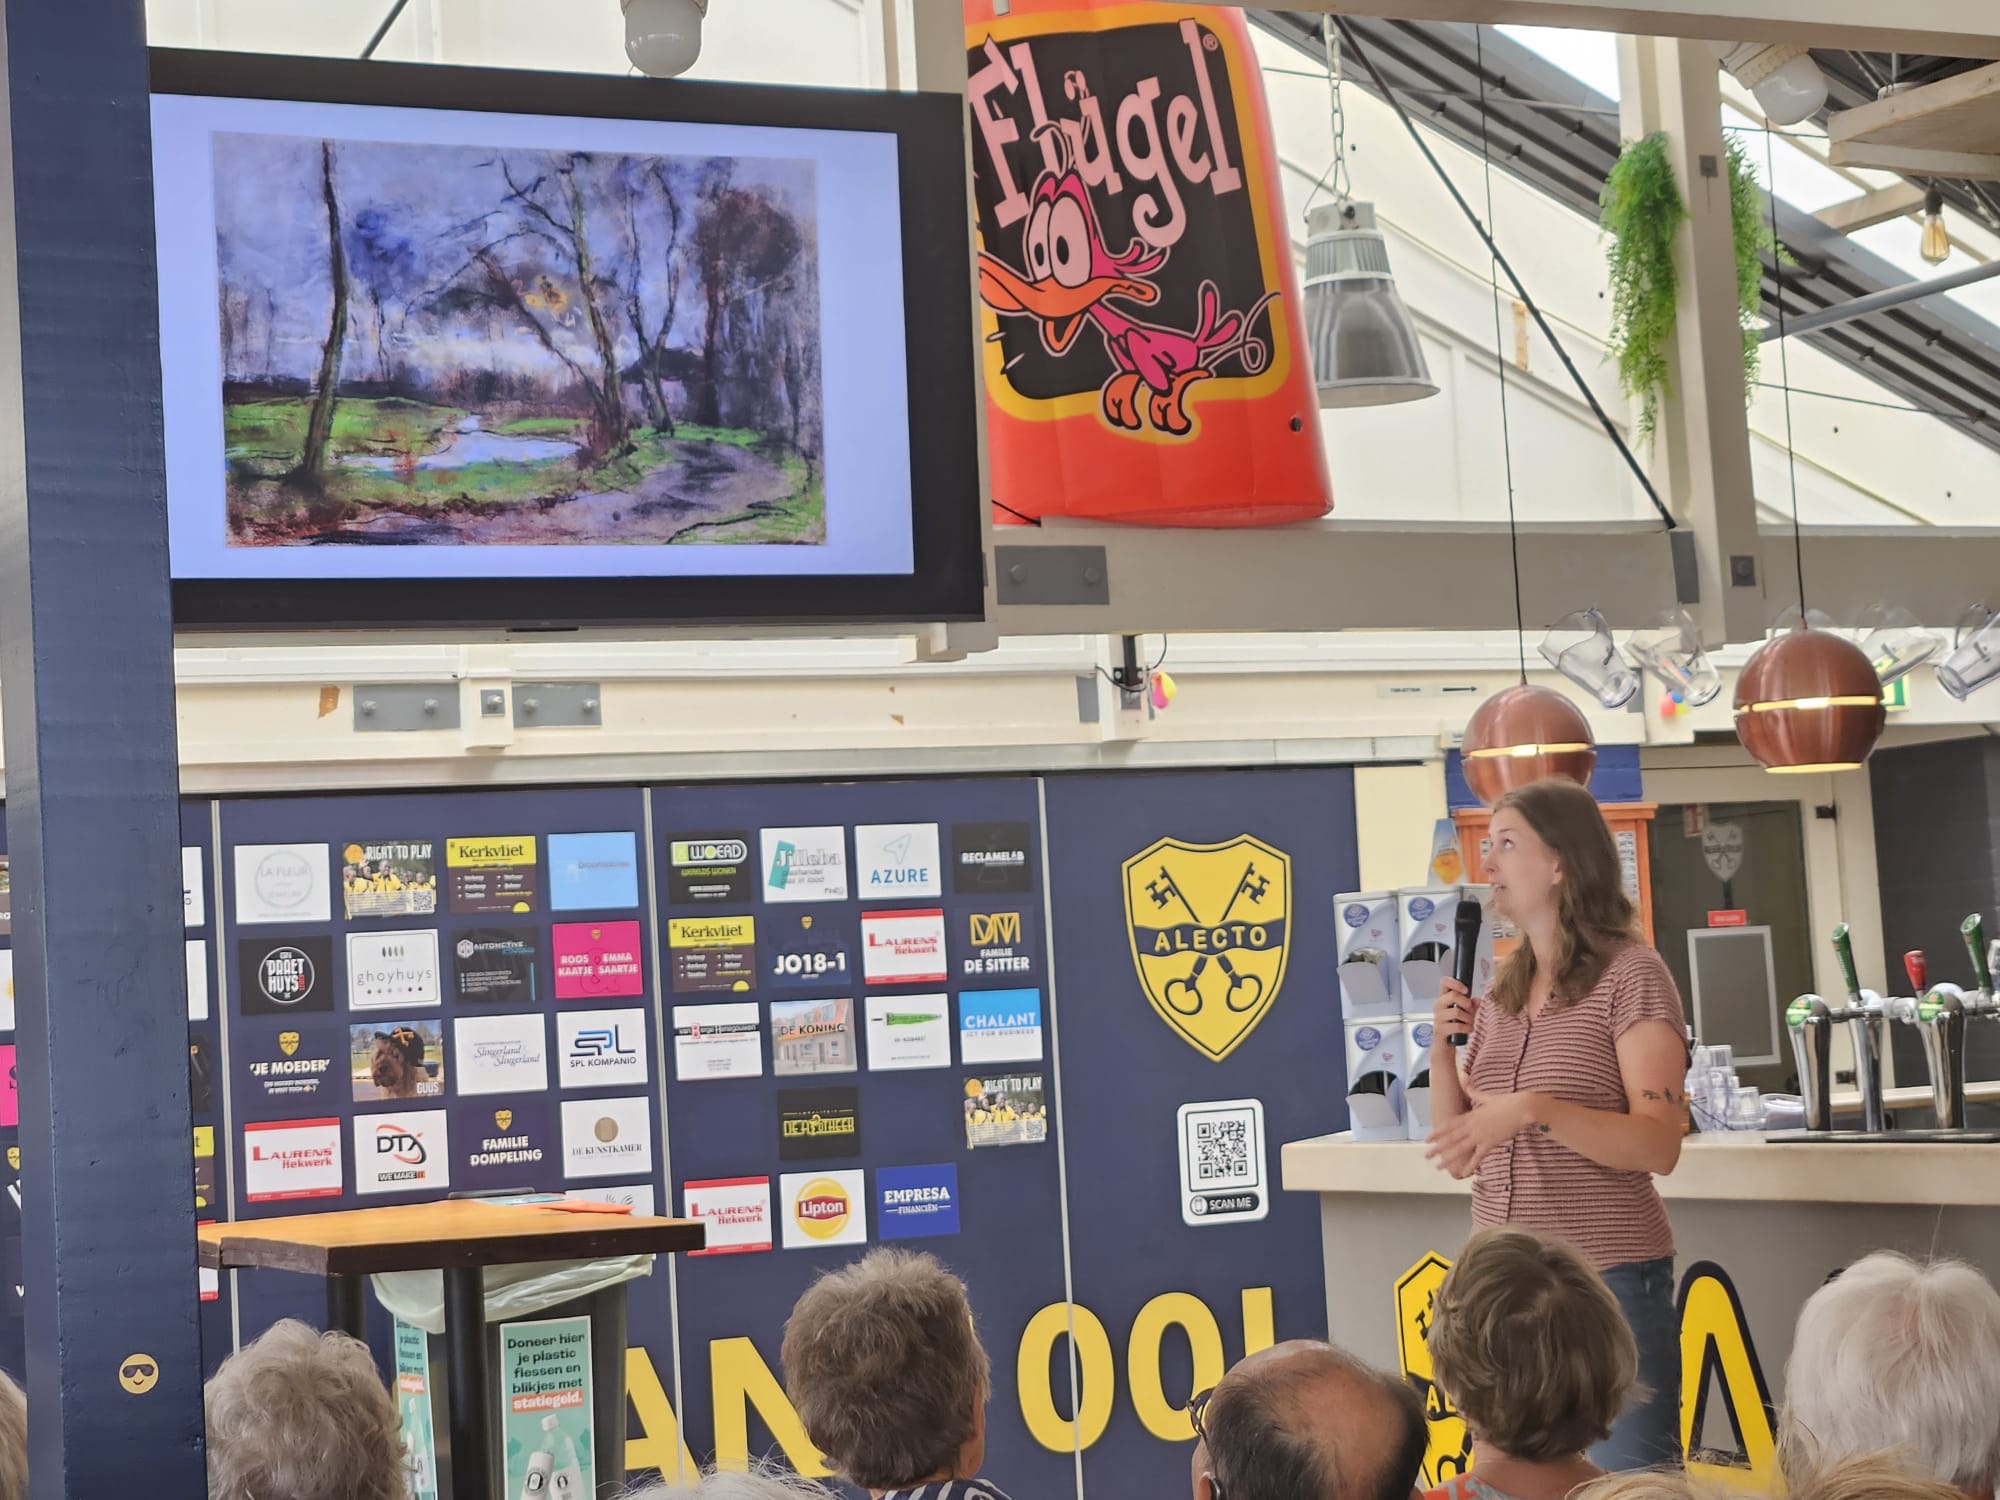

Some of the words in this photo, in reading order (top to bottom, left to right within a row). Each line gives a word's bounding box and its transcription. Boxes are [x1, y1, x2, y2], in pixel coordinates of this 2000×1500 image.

[365, 846, 393, 860] RIGHT
[397, 845, 409, 859] TO
[411, 844, 432, 858] PLAY
[459, 843, 524, 858] Kerkvliet
[961, 850, 1024, 864] RECLAMELAB
[871, 868, 928, 883] AZURE
[681, 925, 743, 938] Kerkvliet
[1153, 925, 1268, 952] ALECTO
[869, 933, 938, 947] LAURENS
[894, 945, 938, 956] Hekwerk
[980, 948, 1013, 958] FAMILIE
[561, 954, 589, 964] ROOS
[603, 952, 632, 963] EMMA
[773, 952, 846, 975] JO18-1
[964, 960, 984, 973] DE
[986, 957, 1030, 971] SITTER
[357, 968, 432, 985] ghoyhuys
[558, 966, 593, 977] KAATJE
[599, 963, 639, 975] SAARTJE
[267, 975, 299, 993] HUYS
[965, 1013, 1036, 1029] CHALANT
[781, 1025, 796, 1035] DE
[799, 1023, 846, 1035] KONING
[999, 1028, 1036, 1036] BUSINESS
[569, 1024, 636, 1057] SPL
[570, 1059, 585, 1068] SPL
[587, 1056, 637, 1066] KOMPANIO
[416, 1082, 440, 1095] GUUS
[983, 1079, 1008, 1092] RIGHT
[1011, 1078, 1022, 1091] TO
[1023, 1076, 1042, 1091] PLAY
[482, 1136, 529, 1150] FAMILIE
[585, 1143, 642, 1155] KUNSTKAMER
[252, 1146, 333, 1161] LAURENS
[469, 1149, 543, 1167] DOMPELING
[282, 1158, 333, 1169] Hekwerk
[378, 1171, 392, 1182] WE
[393, 1171, 416, 1181] MAKE
[884, 1187, 950, 1204] EMPRESA
[691, 1203, 764, 1217] LAURENS
[800, 1201, 844, 1218] Lipton
[1208, 1198, 1234, 1210] SCAN
[1236, 1196, 1252, 1209] ME
[718, 1214, 763, 1225] Hekwerk
[507, 1337, 557, 1349] Doneer
[560, 1333, 585, 1344] hier
[517, 1352, 530, 1366] je
[533, 1348, 577, 1365] plastic
[514, 1366, 563, 1378] flessen
[566, 1364, 581, 1374] en
[513, 1381, 556, 1394] blikjes
[558, 1378, 583, 1390] met
[514, 1391, 583, 1409] statiegeld.
